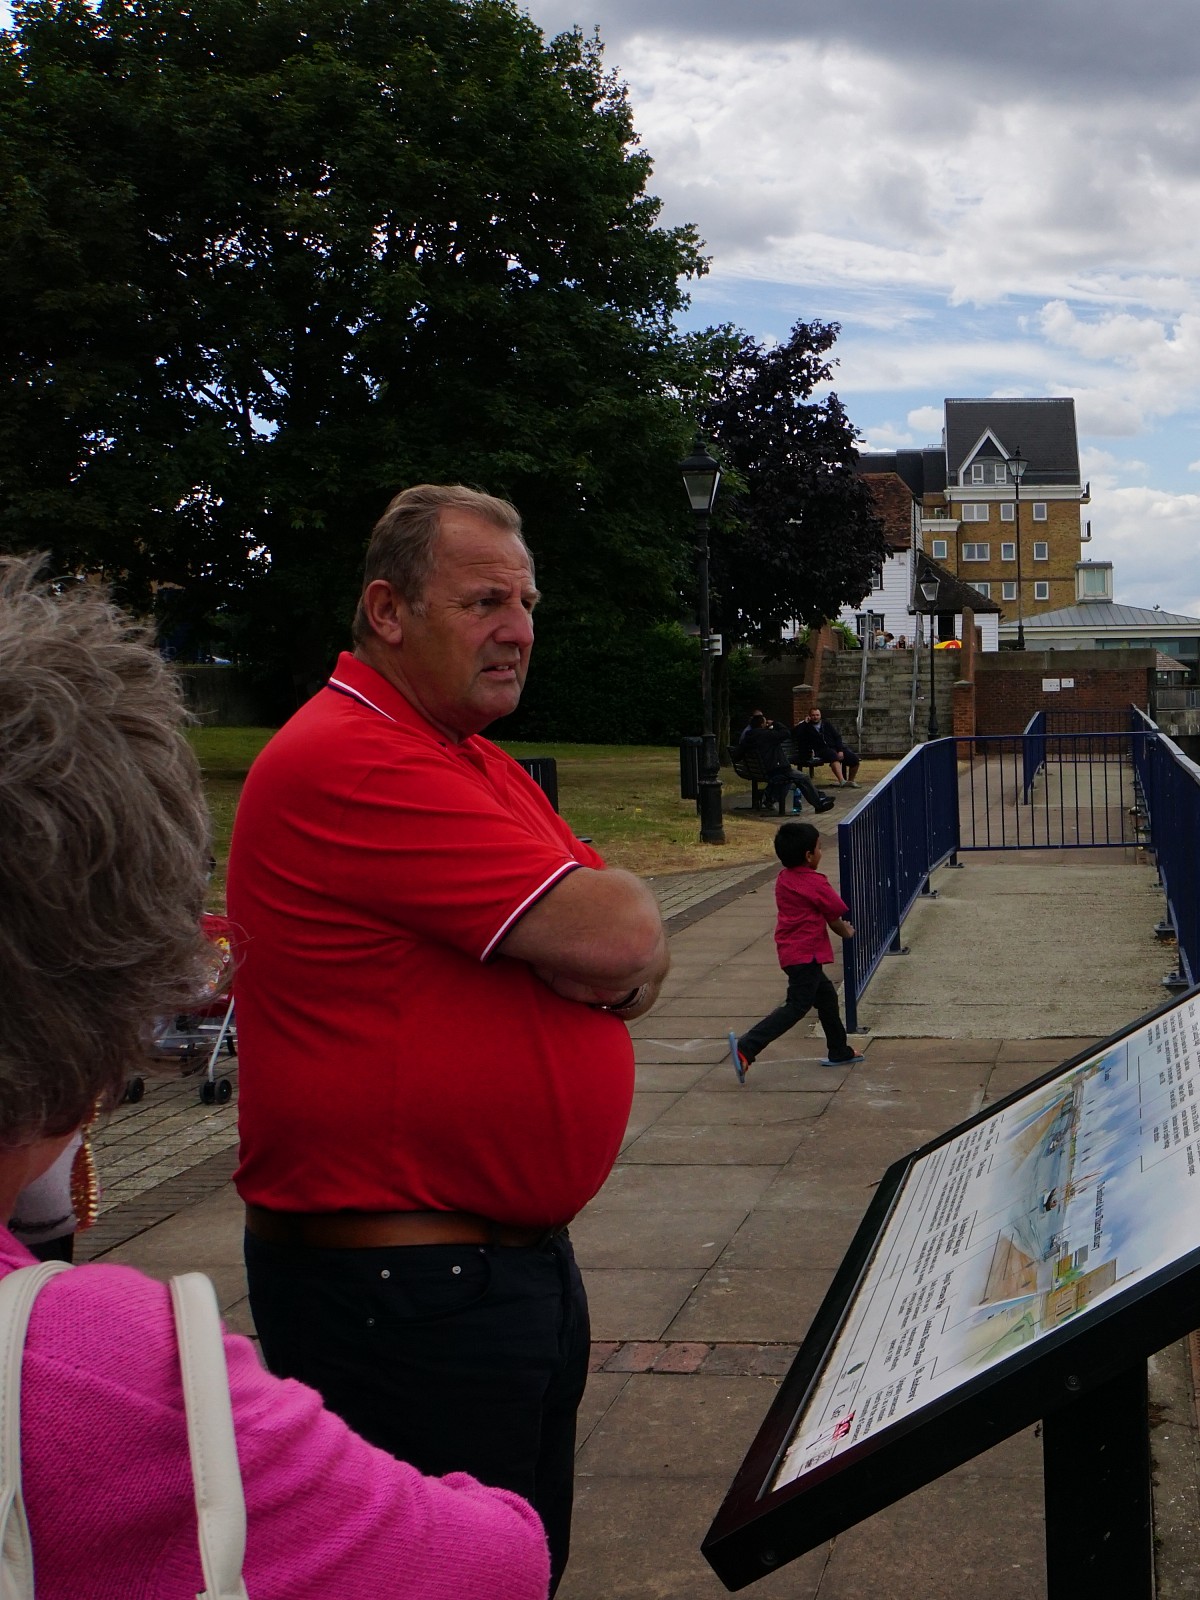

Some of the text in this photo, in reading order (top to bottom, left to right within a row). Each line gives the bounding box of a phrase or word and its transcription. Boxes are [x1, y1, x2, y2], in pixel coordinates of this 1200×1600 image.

[1096, 1180, 1106, 1189] To
[1096, 1186, 1105, 1206] Southend
[1095, 1208, 1103, 1217] the
[1094, 1214, 1103, 1233] Thames
[1091, 1230, 1103, 1251] Estuary
[935, 1270, 954, 1310] Royal Terrace Pier
[912, 1316, 935, 1367] London River House
[906, 1376, 921, 1403] Andrew's
